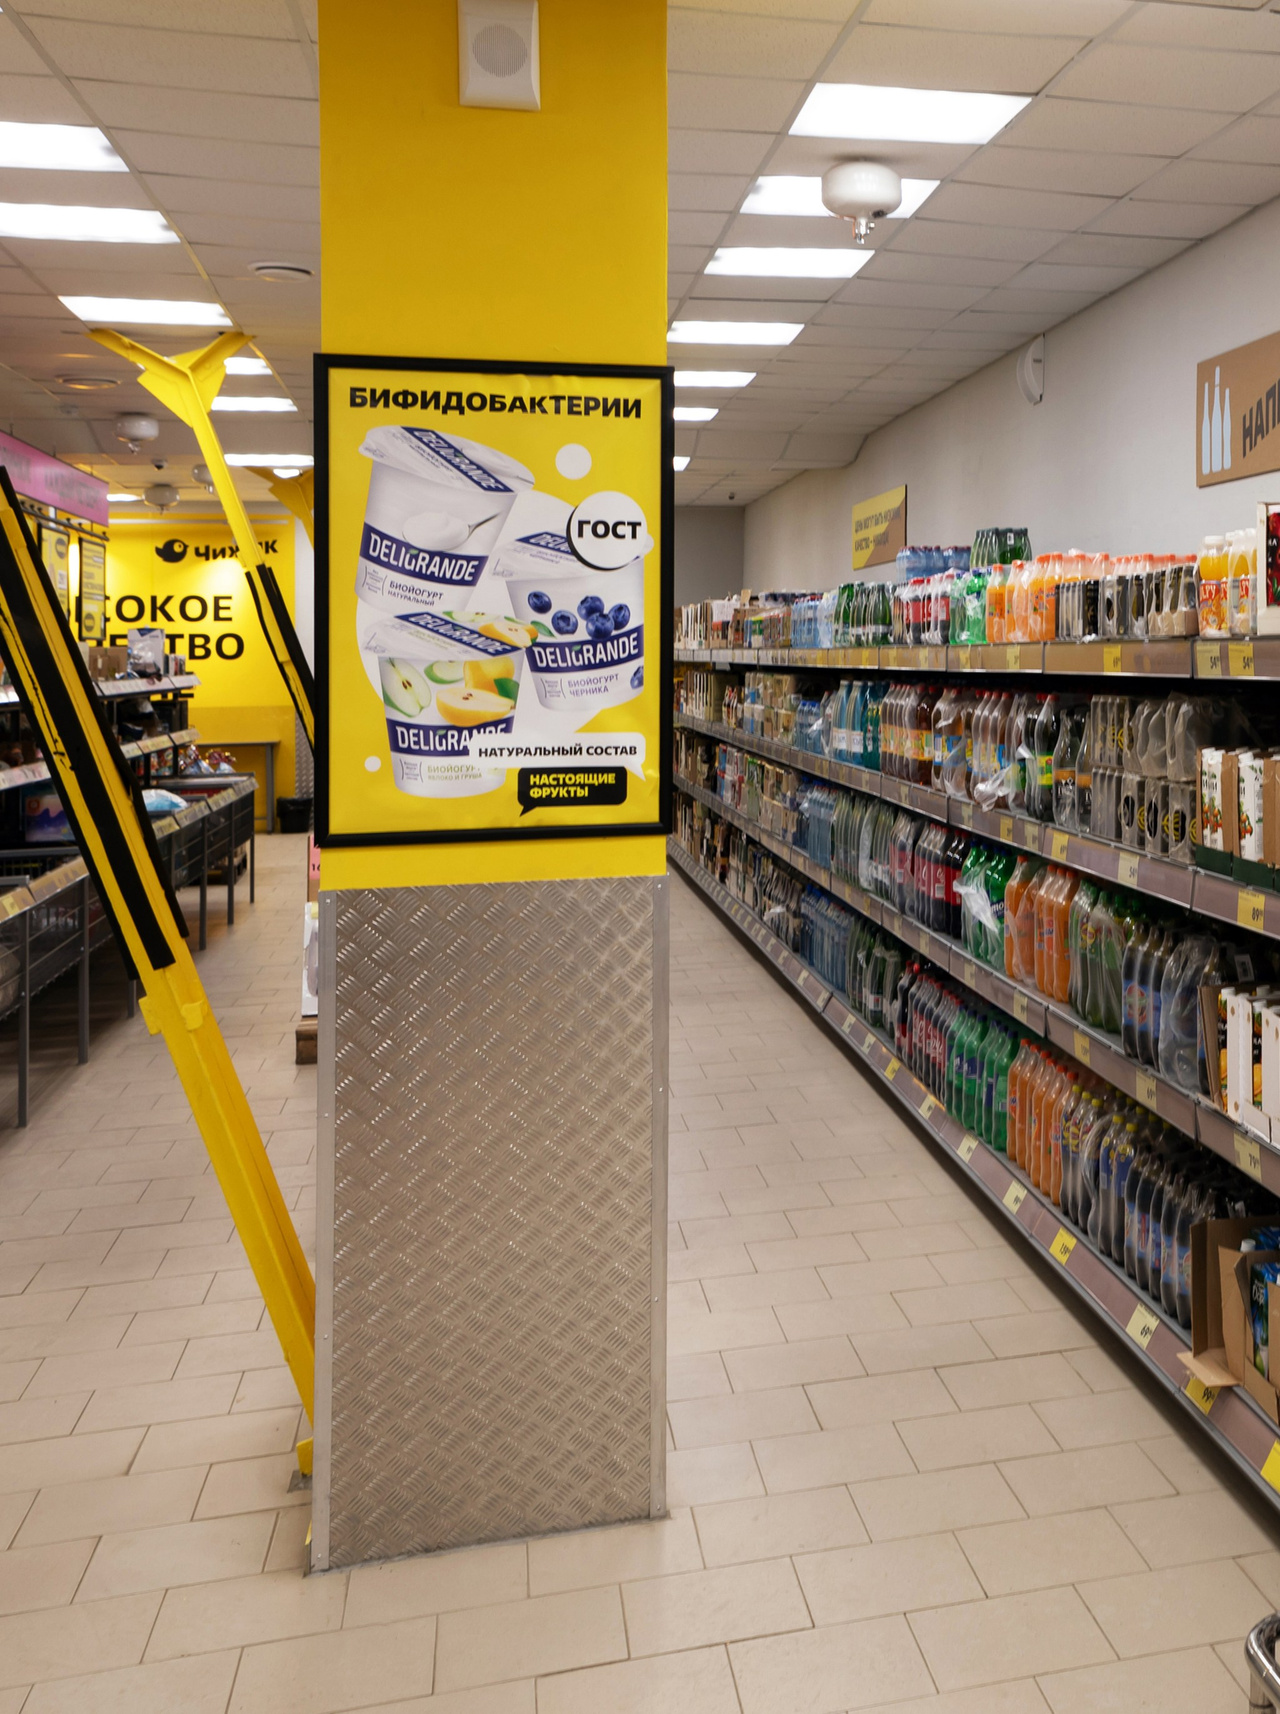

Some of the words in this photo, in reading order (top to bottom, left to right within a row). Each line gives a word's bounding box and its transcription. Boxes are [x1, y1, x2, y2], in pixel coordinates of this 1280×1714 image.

[349, 387, 642, 418] БИФИДОБАКТЕРИИ
[576, 519, 642, 540] ГОСТ
[368, 532, 480, 581] DELIGRANDE
[387, 590, 435, 606] НАТУРАЛЬНЫЙ
[389, 580, 444, 600] БИОЙОГУРТ
[532, 632, 639, 669] DELIGRANDE
[567, 673, 619, 688] БИОЙОГУРТ
[569, 685, 609, 698] ЧЕРНИКА
[478, 743, 583, 757] НАТУРАЛЬНЫЙ
[585, 745, 638, 756] СОСТАВ
[529, 773, 616, 787] НАСТОЯЩИЕ
[529, 786, 589, 799] ФРУКТЫ
